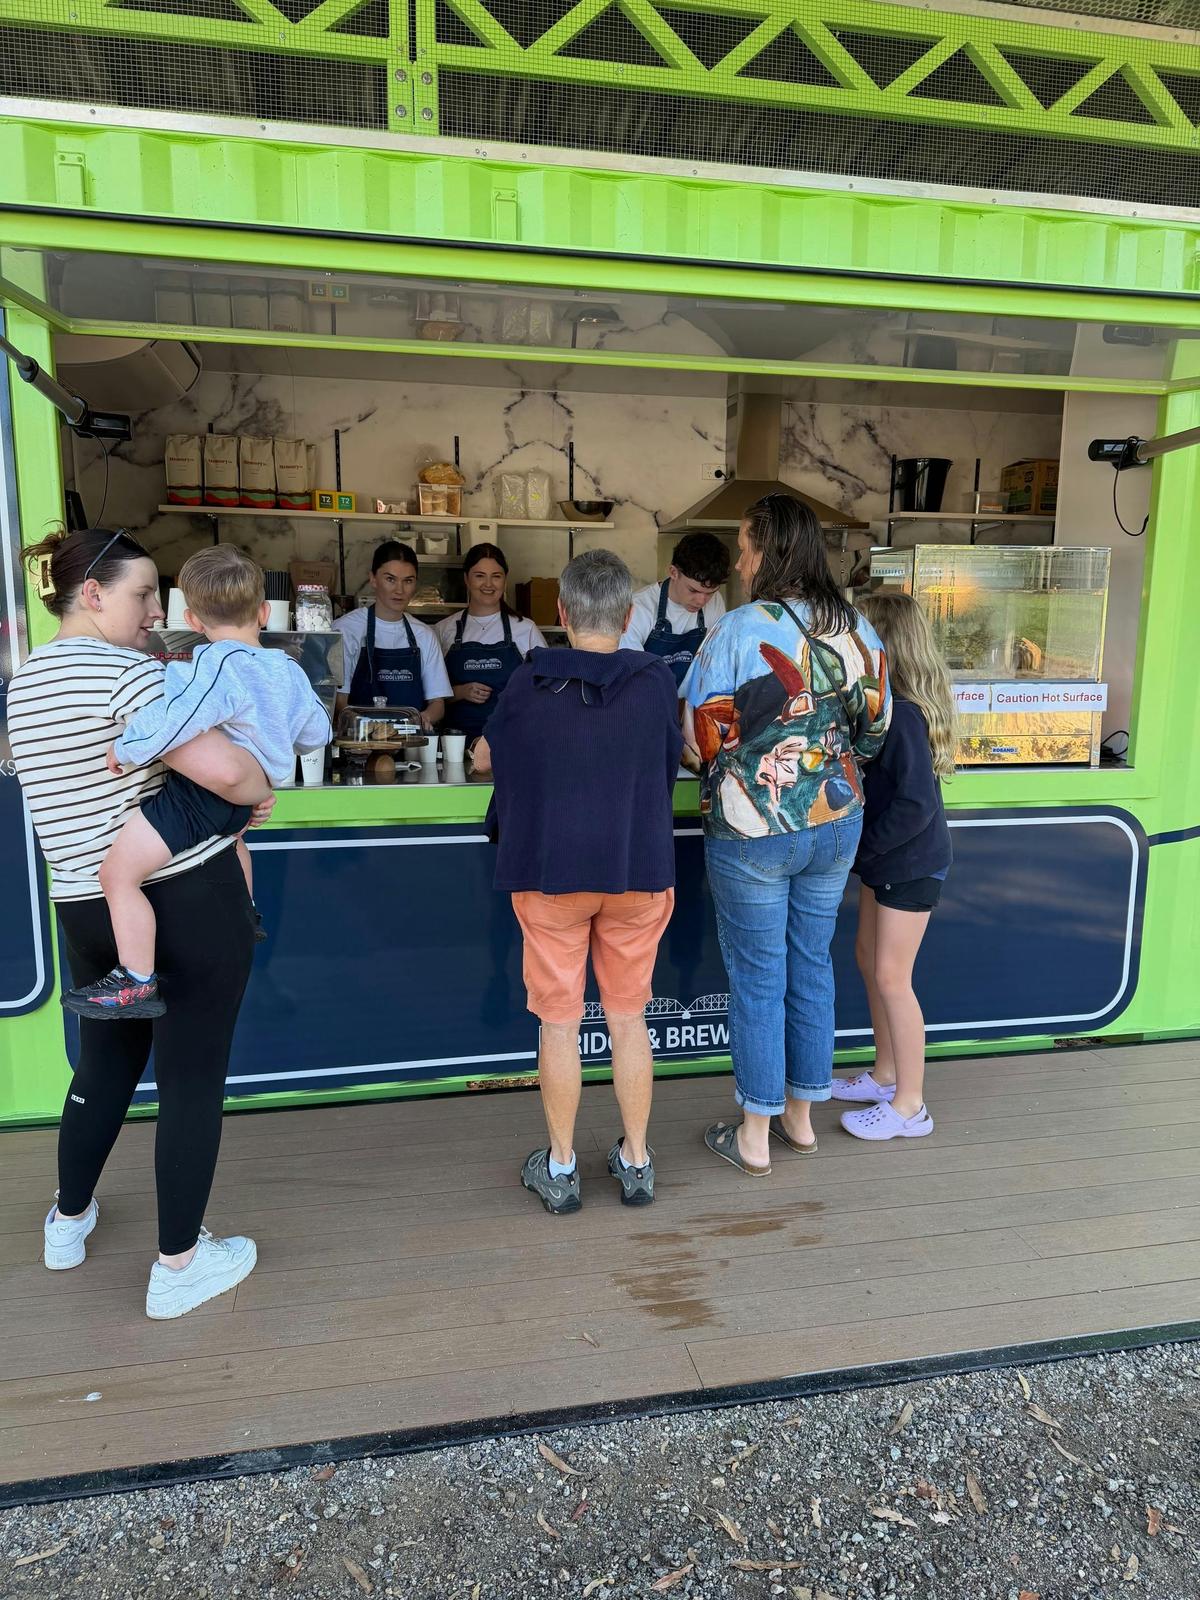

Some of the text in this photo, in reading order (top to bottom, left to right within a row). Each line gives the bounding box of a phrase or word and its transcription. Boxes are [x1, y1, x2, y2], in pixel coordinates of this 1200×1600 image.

[321, 495, 331, 503] T2
[953, 691, 985, 701] rface
[996, 691, 1103, 704] Caution Hot Surface
[649, 1028, 661, 1050] &
[666, 1023, 729, 1049] BREW
